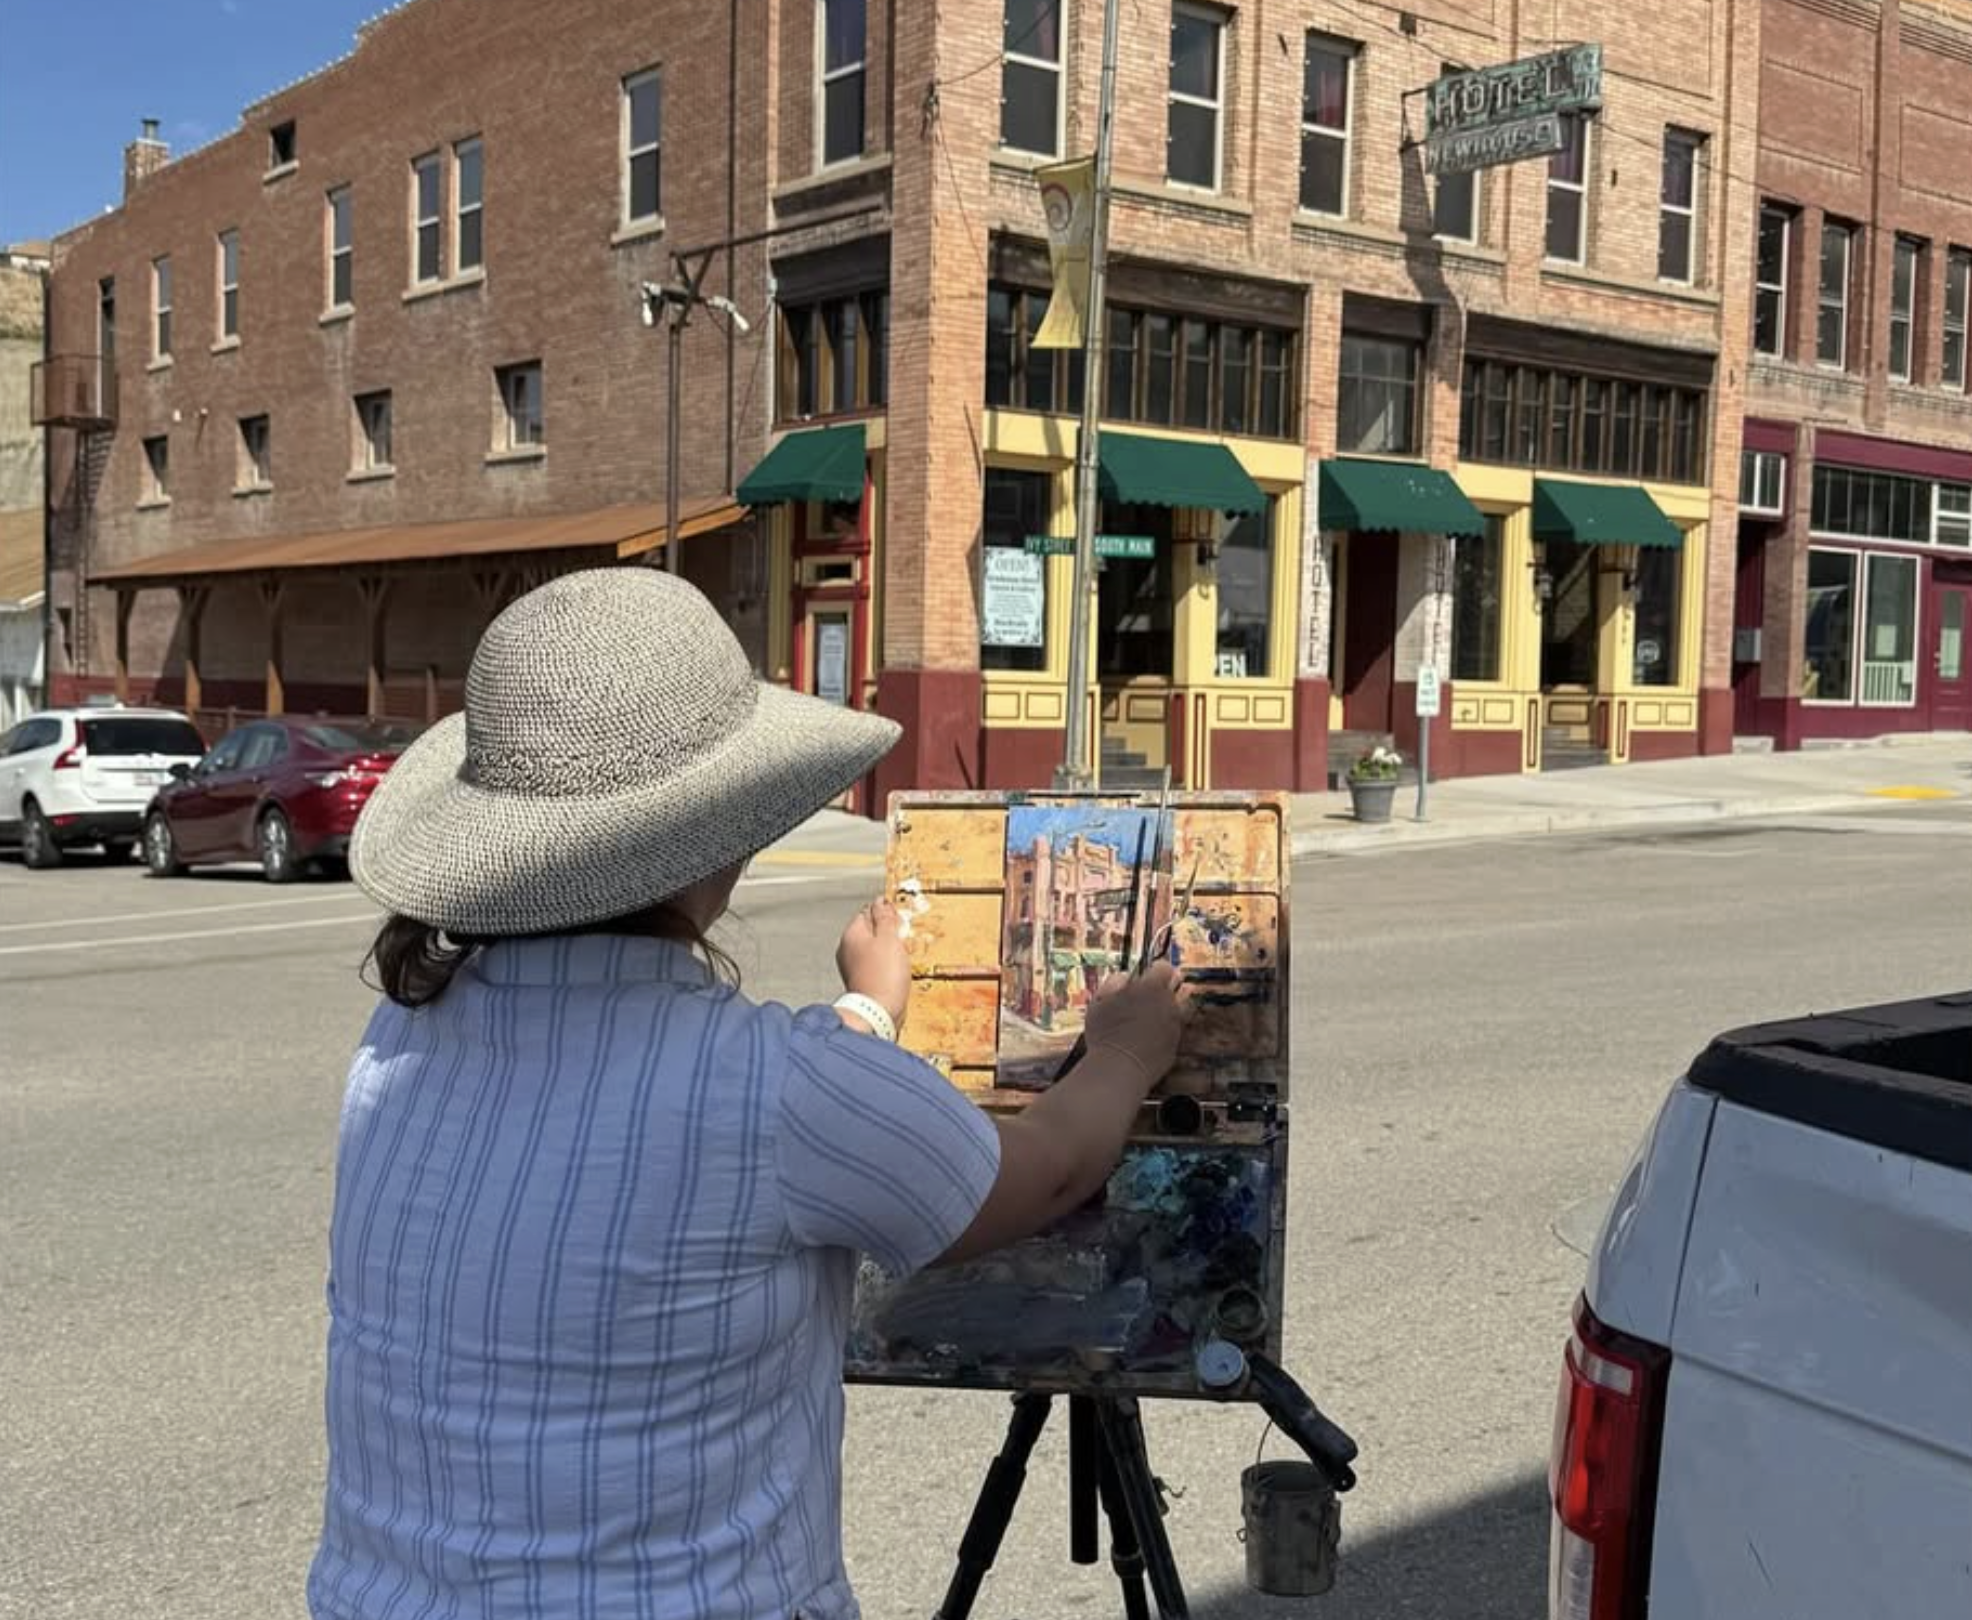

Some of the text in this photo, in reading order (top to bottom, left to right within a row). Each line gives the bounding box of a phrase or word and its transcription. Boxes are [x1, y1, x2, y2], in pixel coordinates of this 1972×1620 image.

[1434, 56, 1569, 126] HOTEL
[1308, 536, 1324, 667] HOTEL
[1217, 653, 1247, 678] EN
